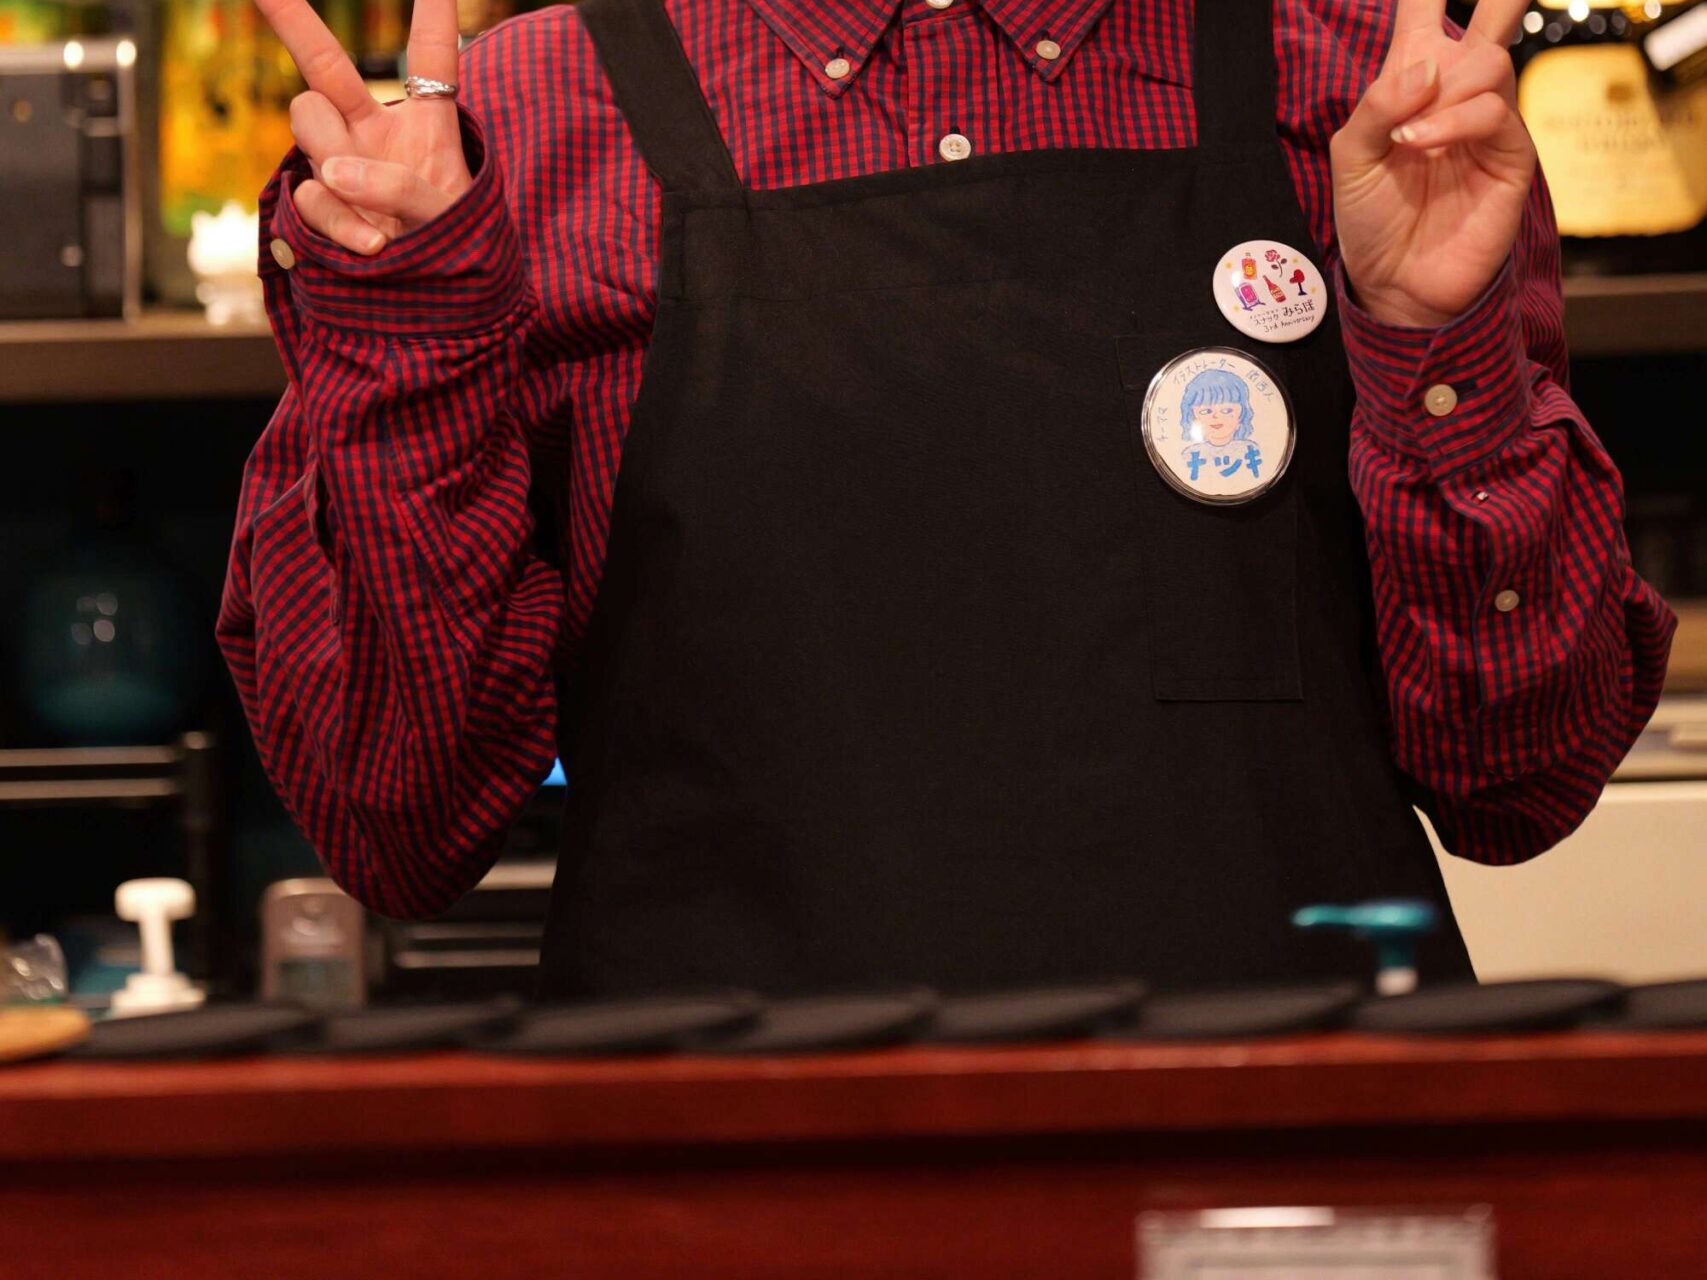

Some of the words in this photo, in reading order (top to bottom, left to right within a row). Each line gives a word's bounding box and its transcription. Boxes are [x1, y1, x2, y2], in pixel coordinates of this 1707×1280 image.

[1172, 357, 1236, 385] イラストレーター
[1186, 444, 1263, 481] ナツキ
